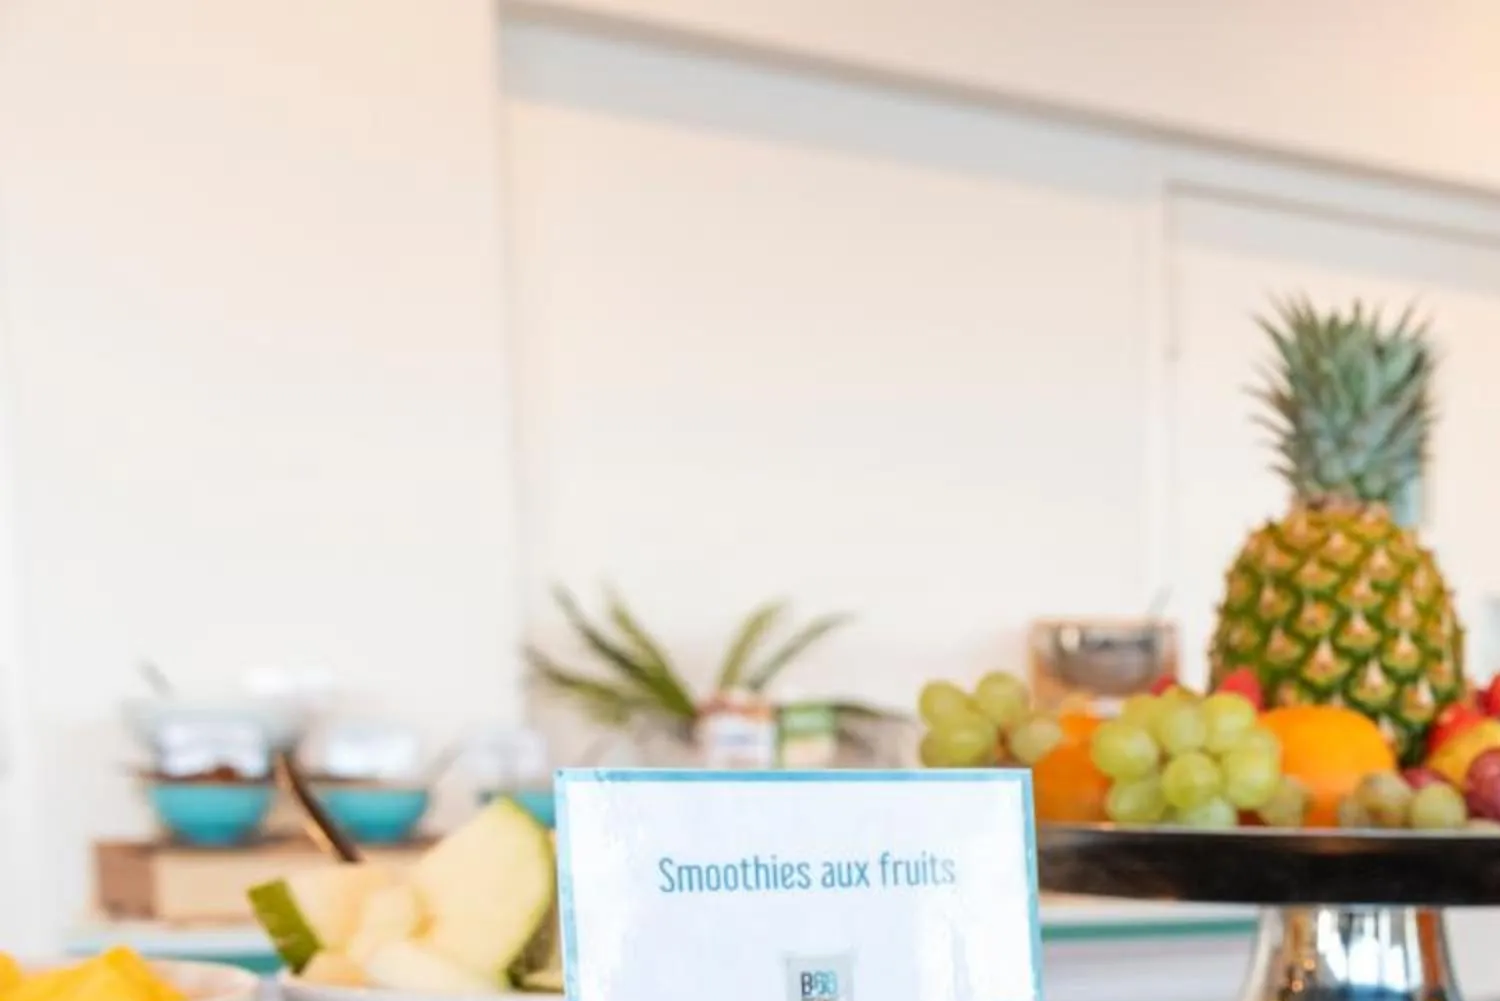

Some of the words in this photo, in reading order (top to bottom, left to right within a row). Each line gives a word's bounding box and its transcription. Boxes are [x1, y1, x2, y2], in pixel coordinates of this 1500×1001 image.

[658, 855, 811, 893] Smoothies
[821, 861, 870, 889] aux
[879, 851, 956, 887] fruits
